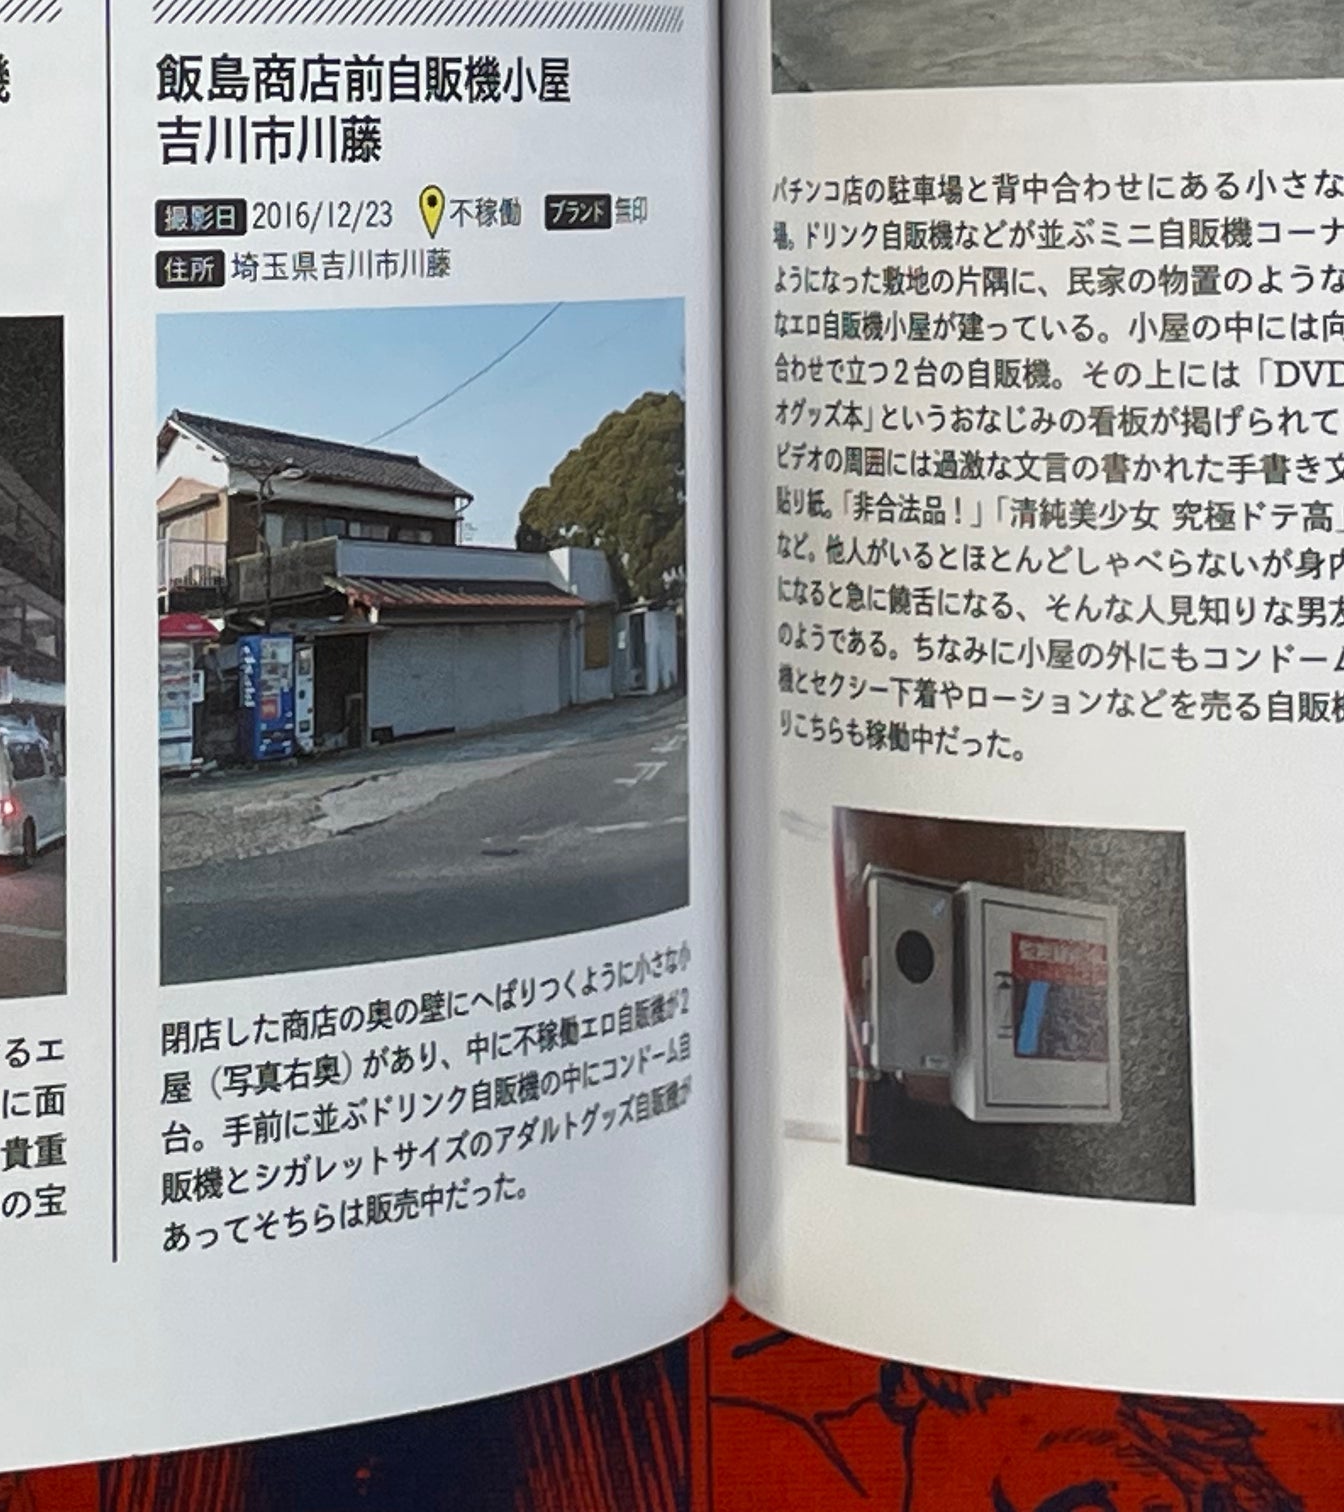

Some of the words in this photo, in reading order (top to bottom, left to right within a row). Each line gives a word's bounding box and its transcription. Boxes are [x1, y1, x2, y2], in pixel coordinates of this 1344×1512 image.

[156, 53, 571, 104] 飯島商店前自販機小屋
[157, 115, 383, 165] 吉川市川藤
[164, 205, 236, 231] 撮影日
[252, 199, 394, 234] 2016/12/23
[449, 196, 522, 229] 不稼働
[549, 200, 605, 224] ブランド
[164, 255, 214, 283] 住所
[231, 247, 451, 283] 埼玉県吉川市川藤
[780, 710, 1024, 762] りこちらも稼働中だった。
[162, 1170, 527, 1254] あってそちらは販売中だった。
